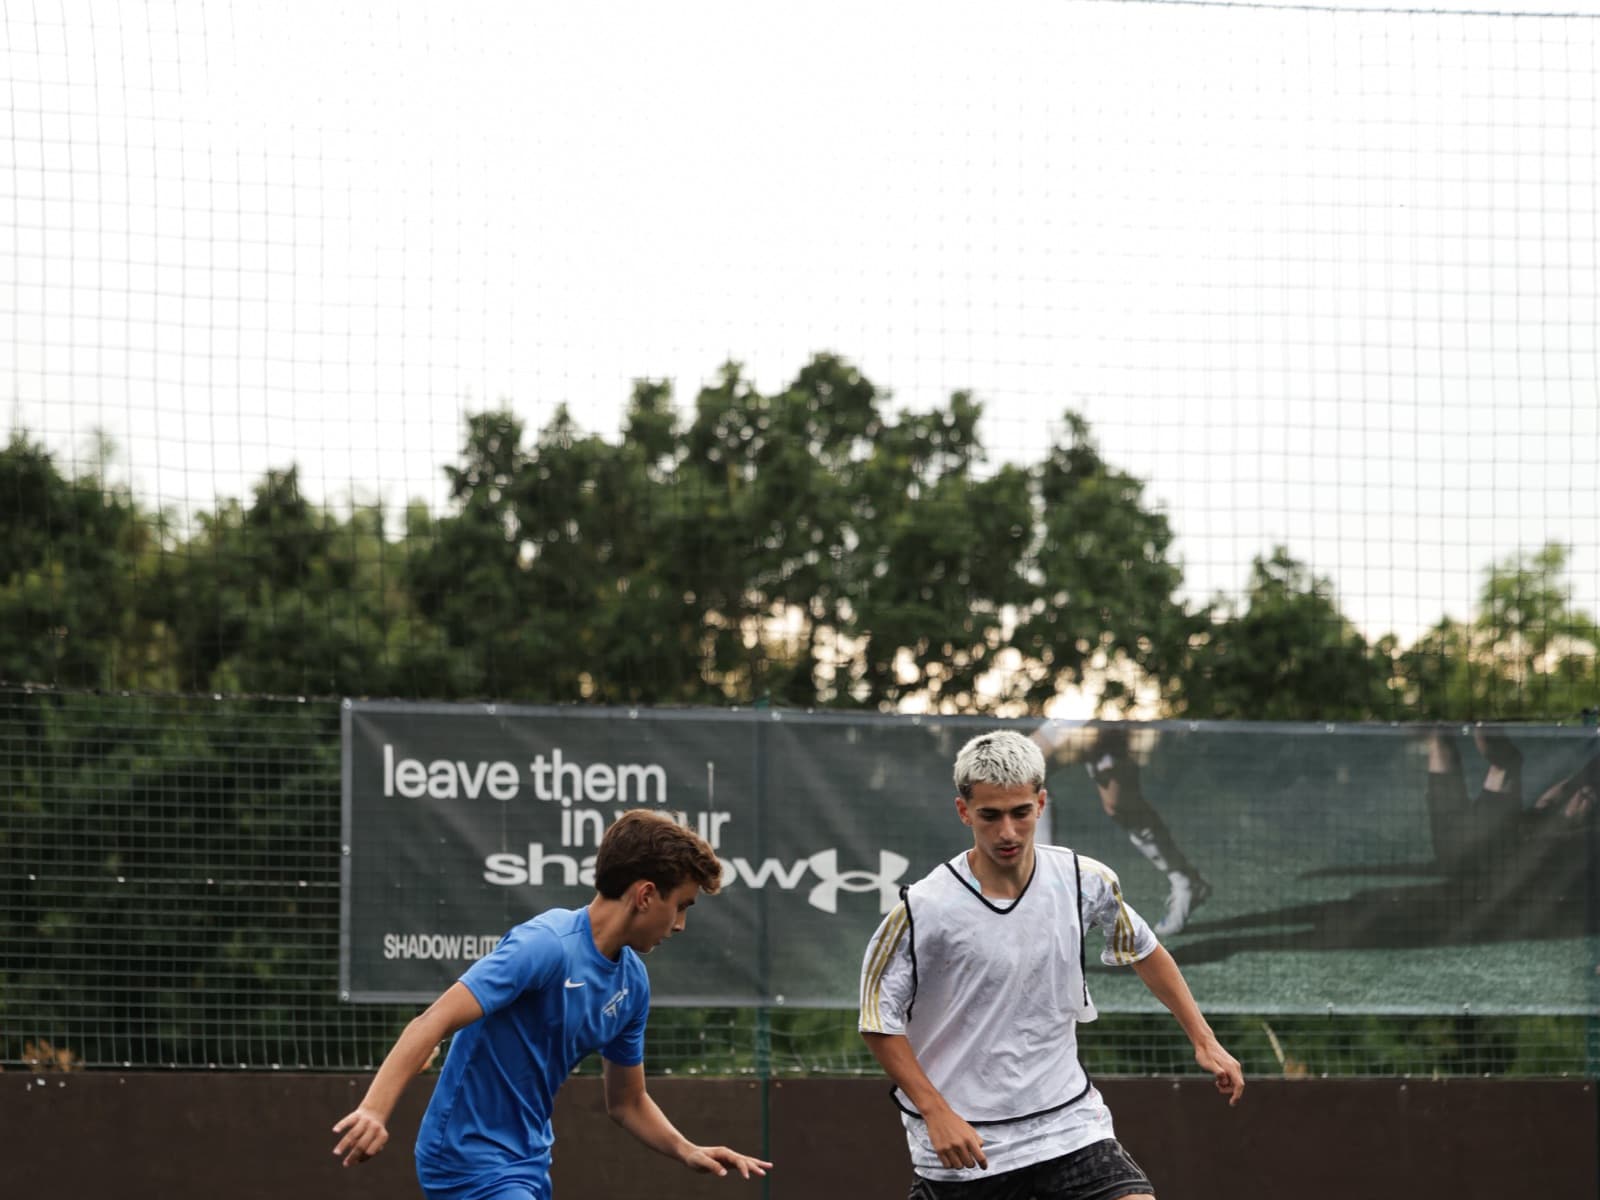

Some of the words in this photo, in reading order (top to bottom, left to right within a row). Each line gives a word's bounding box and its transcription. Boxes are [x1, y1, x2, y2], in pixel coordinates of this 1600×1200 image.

[383, 743, 519, 799] leave
[530, 748, 668, 803] them
[561, 797, 604, 848] in
[383, 933, 461, 960] SHADOW
